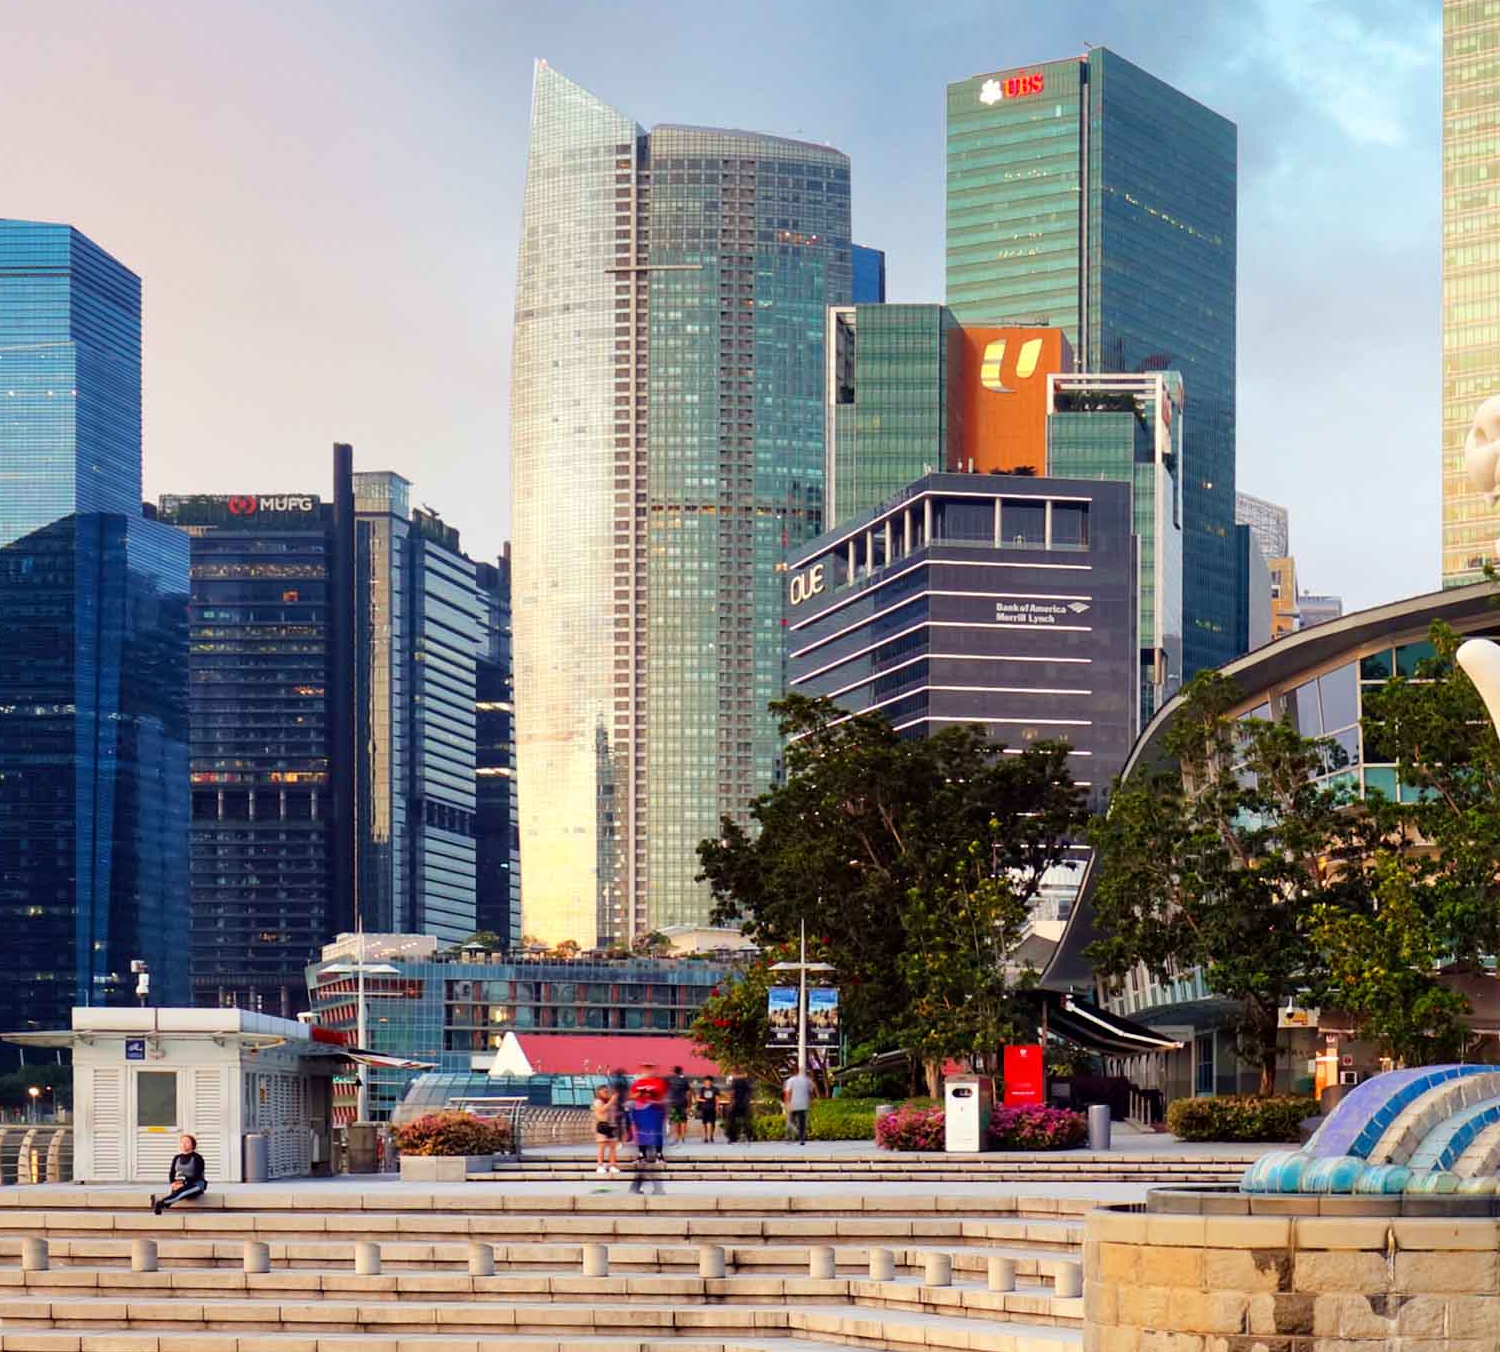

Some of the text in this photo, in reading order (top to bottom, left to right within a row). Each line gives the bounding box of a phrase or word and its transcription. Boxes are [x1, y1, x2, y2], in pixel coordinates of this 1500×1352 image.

[1003, 73, 1044, 98] UBS
[260, 496, 313, 512] MUFG
[790, 563, 825, 606] OUE
[996, 602, 1019, 612] Bank
[1029, 604, 1067, 614] America
[996, 613, 1056, 625] Merrill Lynch
